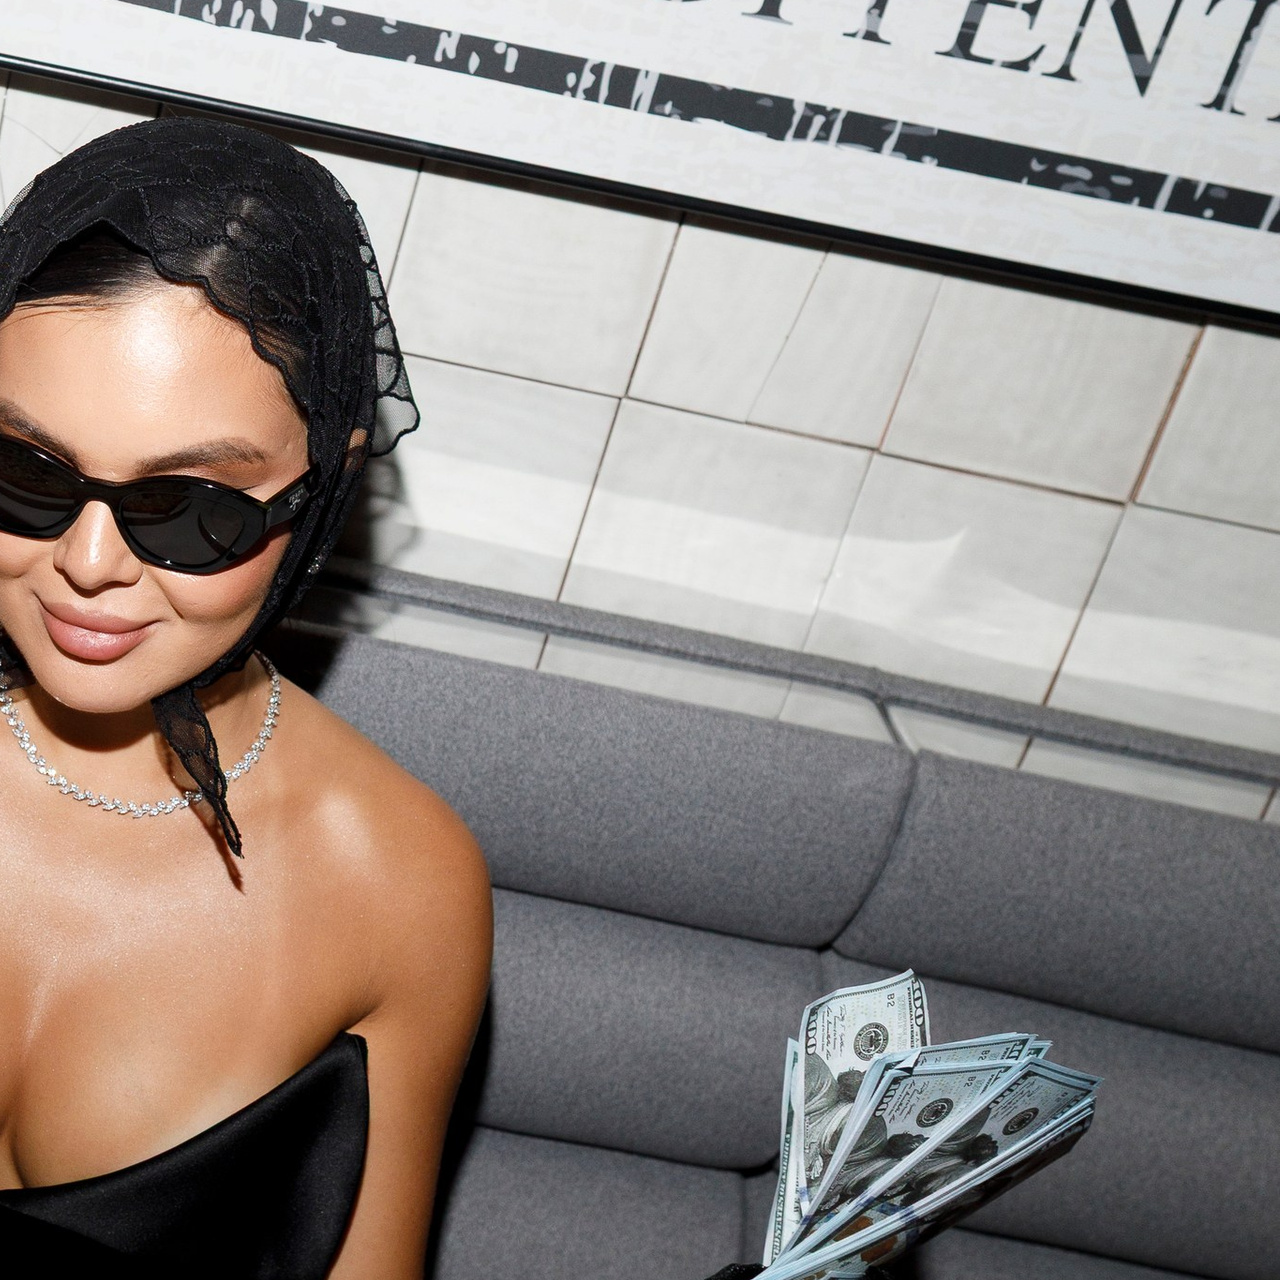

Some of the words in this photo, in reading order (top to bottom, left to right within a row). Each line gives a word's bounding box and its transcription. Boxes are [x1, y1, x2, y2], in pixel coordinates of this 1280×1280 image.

[886, 993, 894, 1008] B2
[978, 1050, 990, 1060] B2
[964, 1077, 976, 1087] B2
